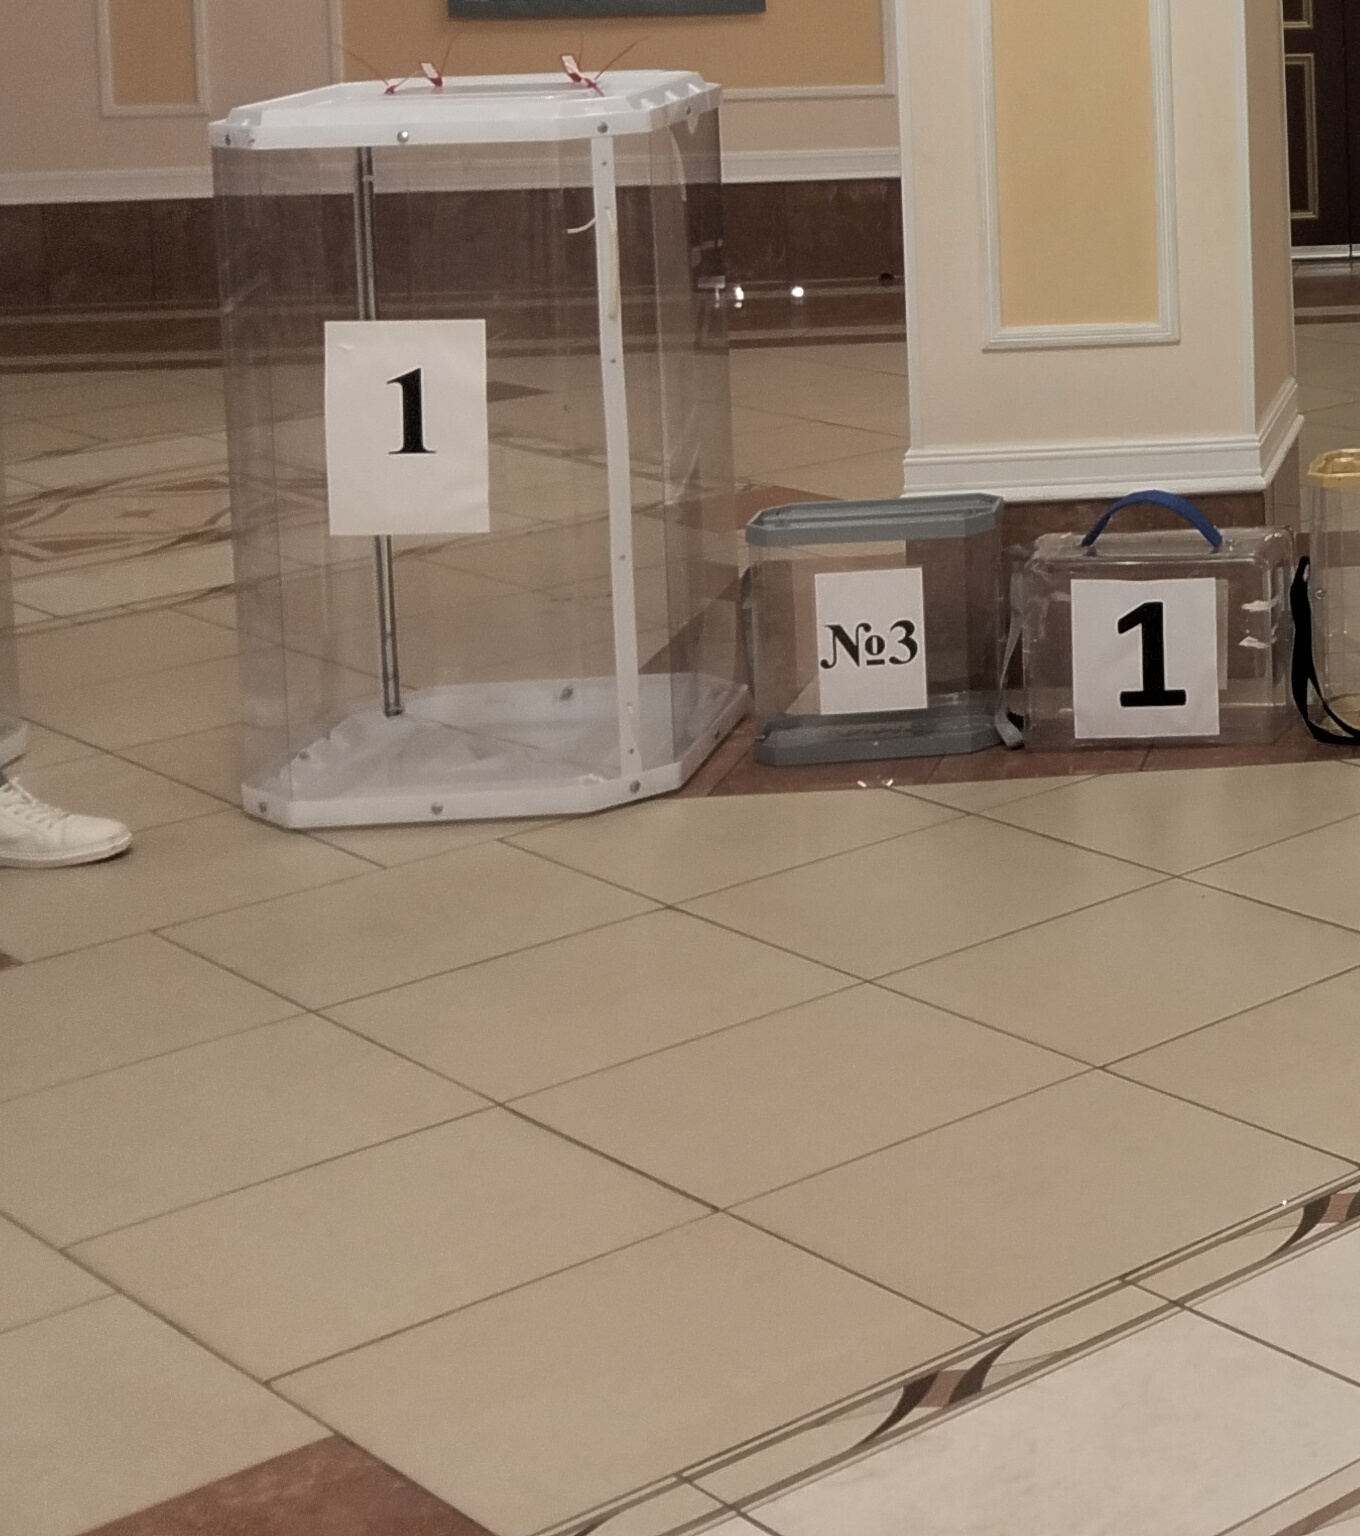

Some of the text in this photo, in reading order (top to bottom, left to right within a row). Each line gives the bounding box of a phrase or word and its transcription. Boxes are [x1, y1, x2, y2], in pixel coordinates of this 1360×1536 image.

[387, 367, 437, 455] 1
[820, 619, 919, 670] №3
[1116, 601, 1188, 708] 1
